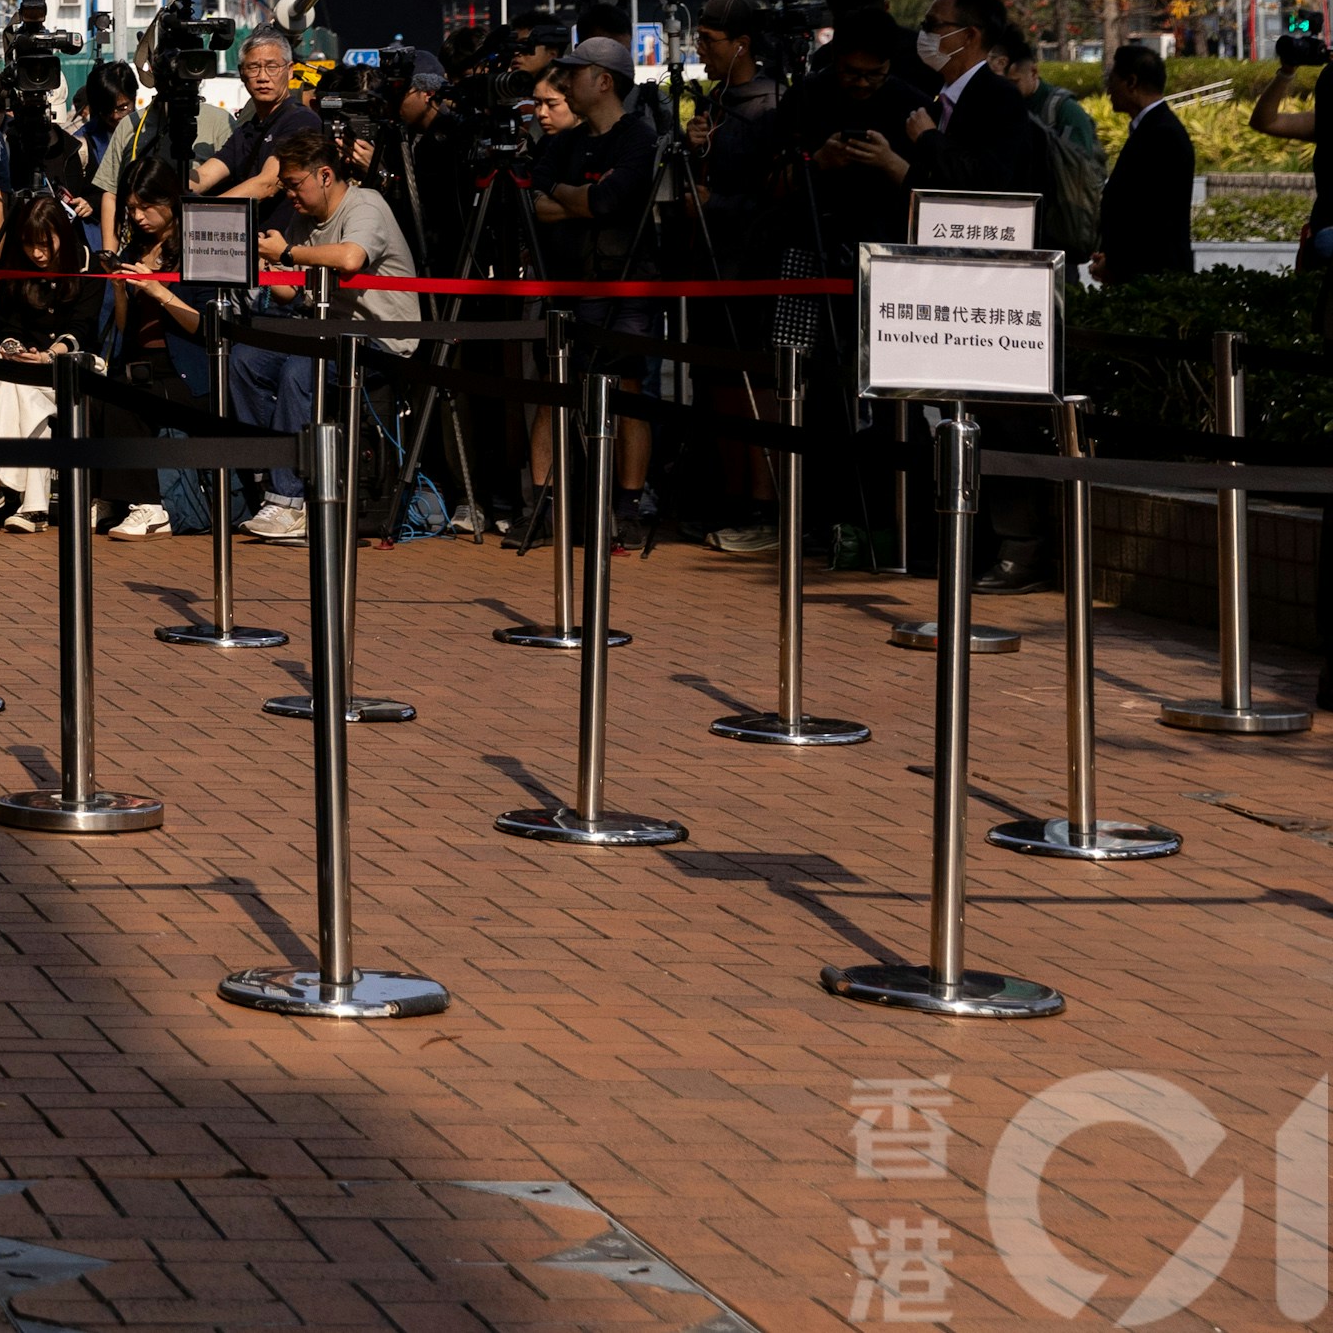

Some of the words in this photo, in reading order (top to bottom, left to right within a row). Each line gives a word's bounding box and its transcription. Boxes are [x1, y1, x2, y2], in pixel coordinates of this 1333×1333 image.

[932, 223, 1016, 242] 公眾排隊處
[188, 246, 210, 256] Involved
[211, 248, 229, 257] Parties
[878, 302, 1043, 328] 相關團體代表排隊處
[877, 329, 939, 345] Involved
[944, 332, 994, 348] Parties
[998, 335, 1045, 351] Queue
